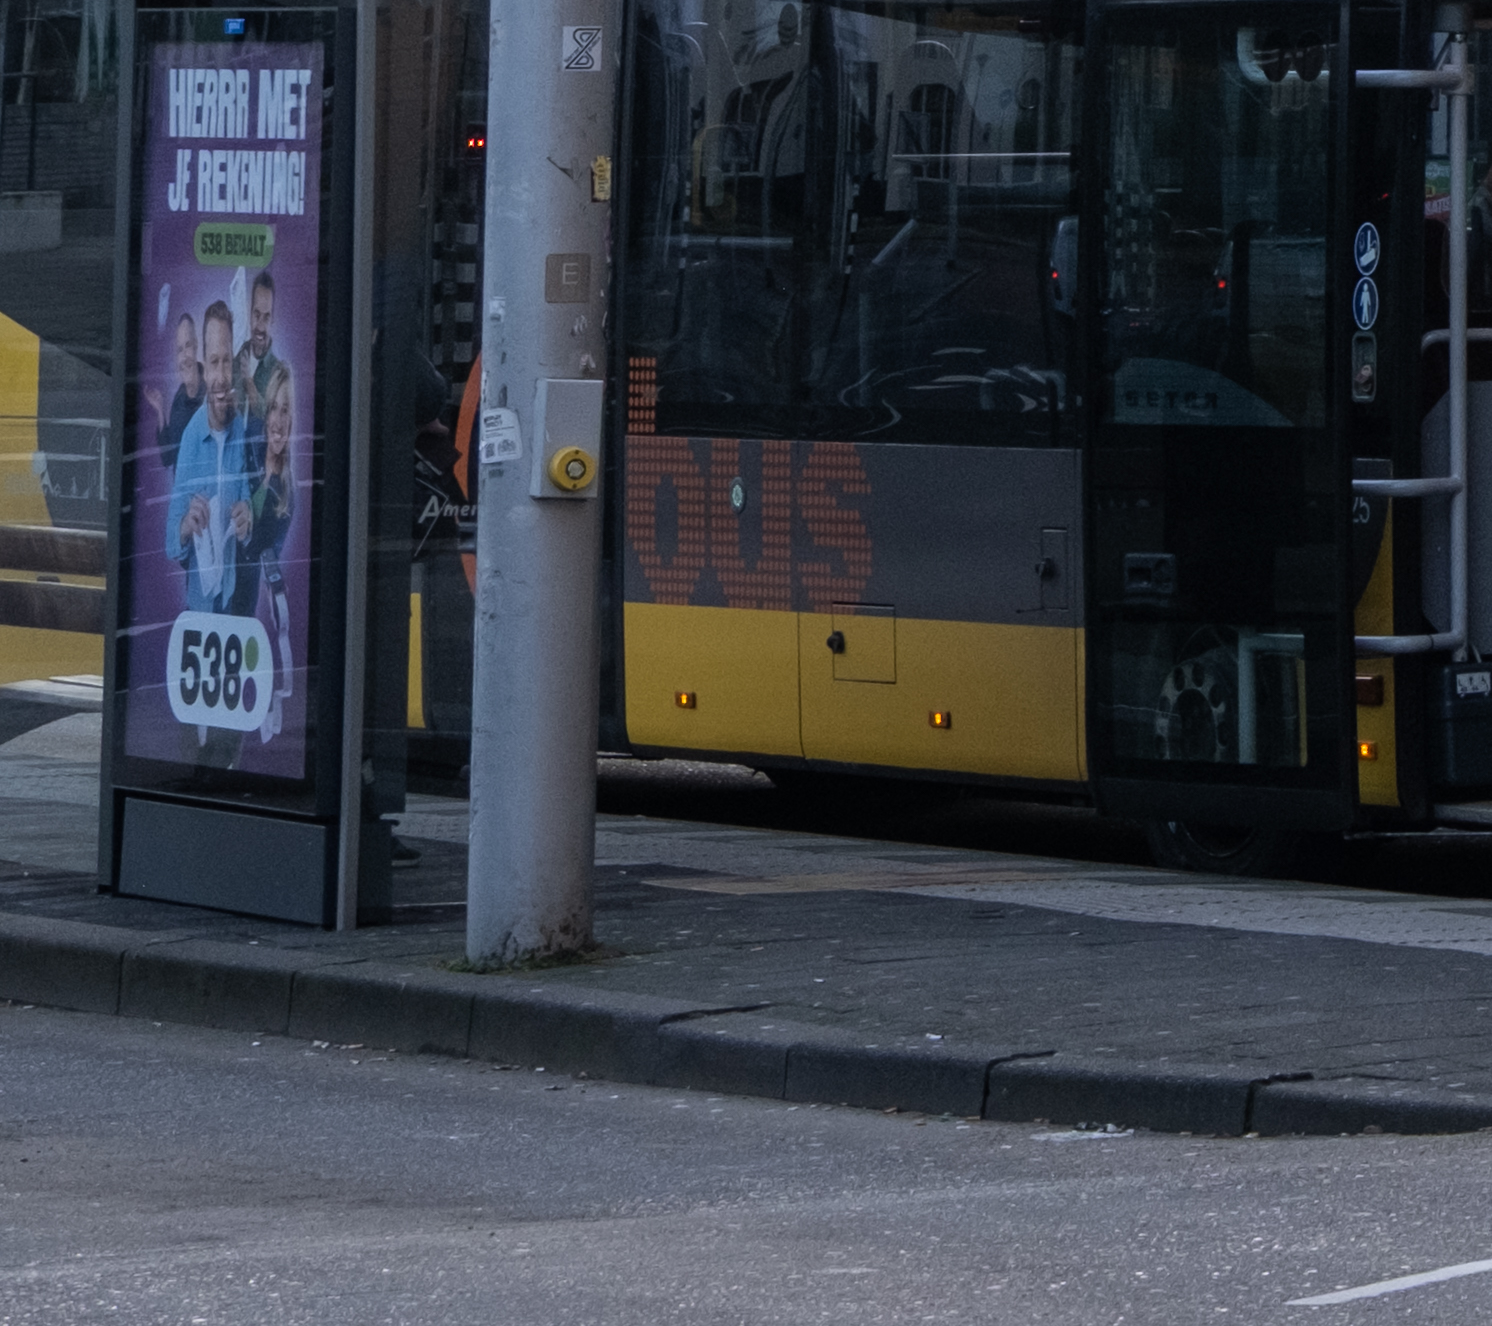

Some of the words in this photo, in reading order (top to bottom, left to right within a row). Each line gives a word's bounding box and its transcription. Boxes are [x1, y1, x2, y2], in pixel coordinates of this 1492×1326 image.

[169, 69, 250, 137] HIERRR
[257, 69, 311, 139] MET
[168, 149, 192, 212] JE
[197, 149, 305, 215] REKENING!
[201, 233, 222, 254] 538
[225, 233, 266, 257] BETAALT
[563, 262, 578, 285] E
[180, 630, 242, 710] 538
